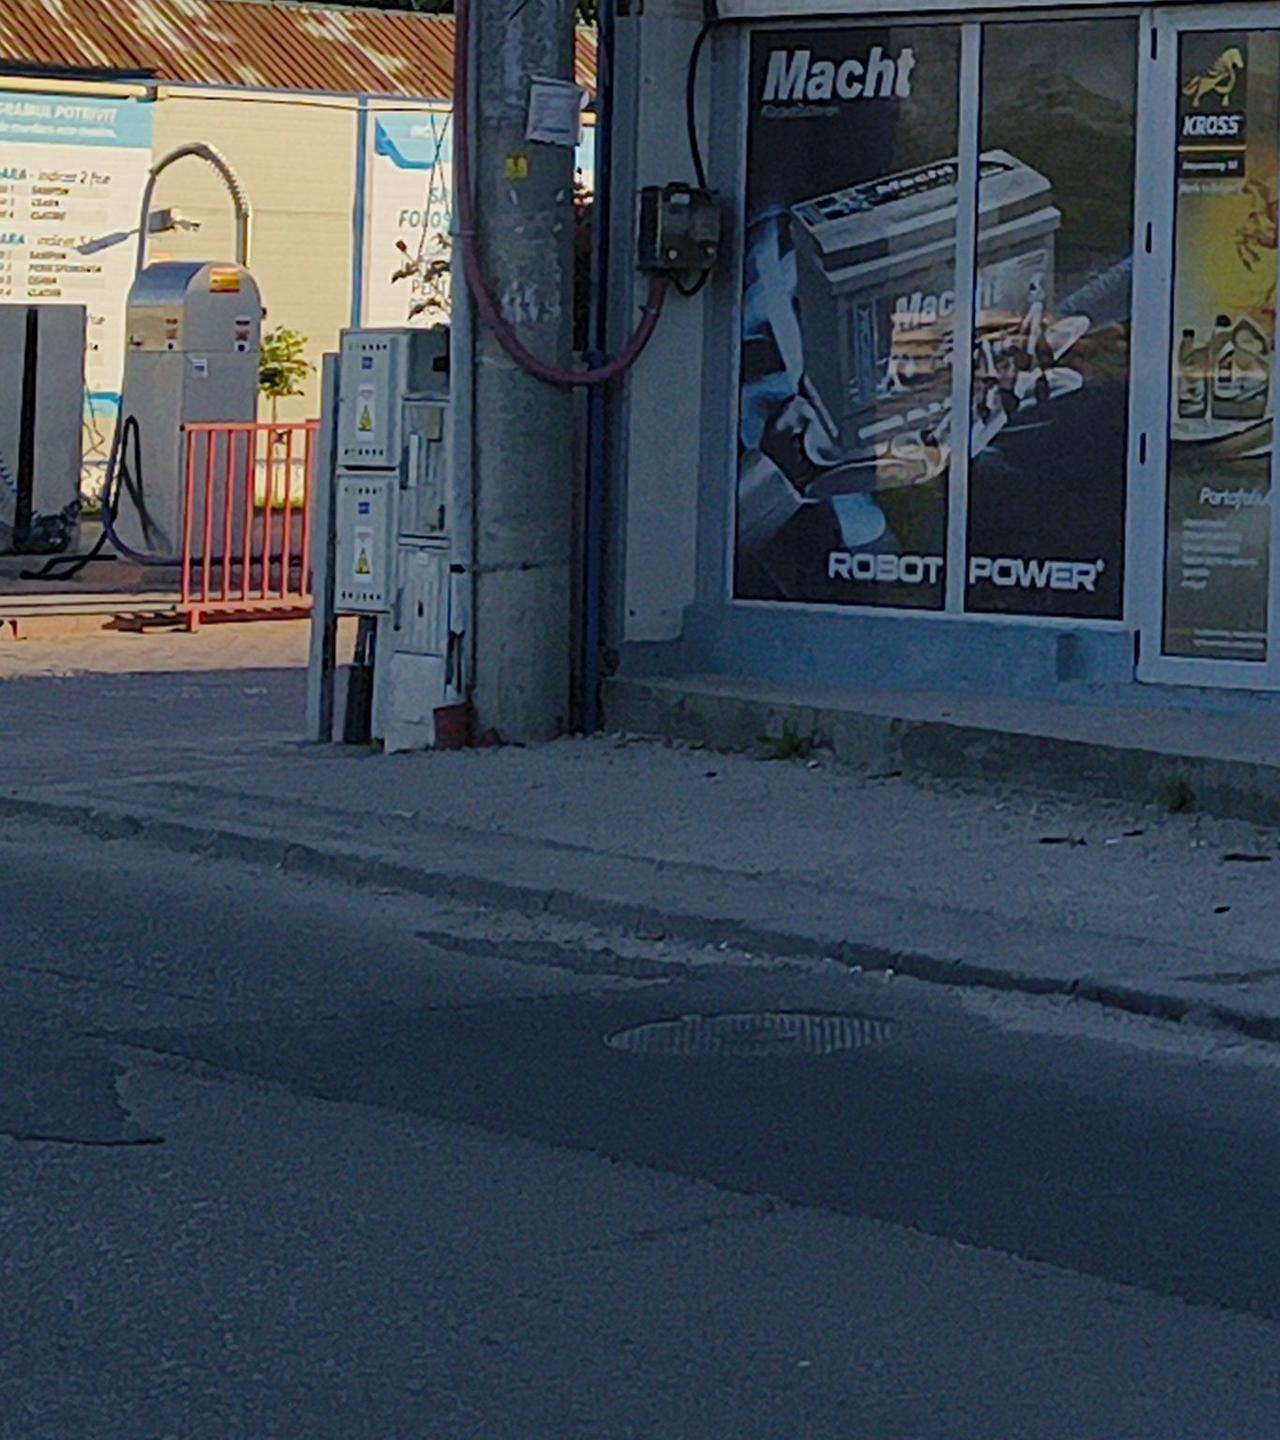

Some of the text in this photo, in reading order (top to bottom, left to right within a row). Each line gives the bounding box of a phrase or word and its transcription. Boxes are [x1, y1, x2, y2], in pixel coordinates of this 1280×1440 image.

[762, 46, 916, 100] Macht
[1183, 115, 1242, 135] KROSS
[828, 552, 943, 584] ROBOT
